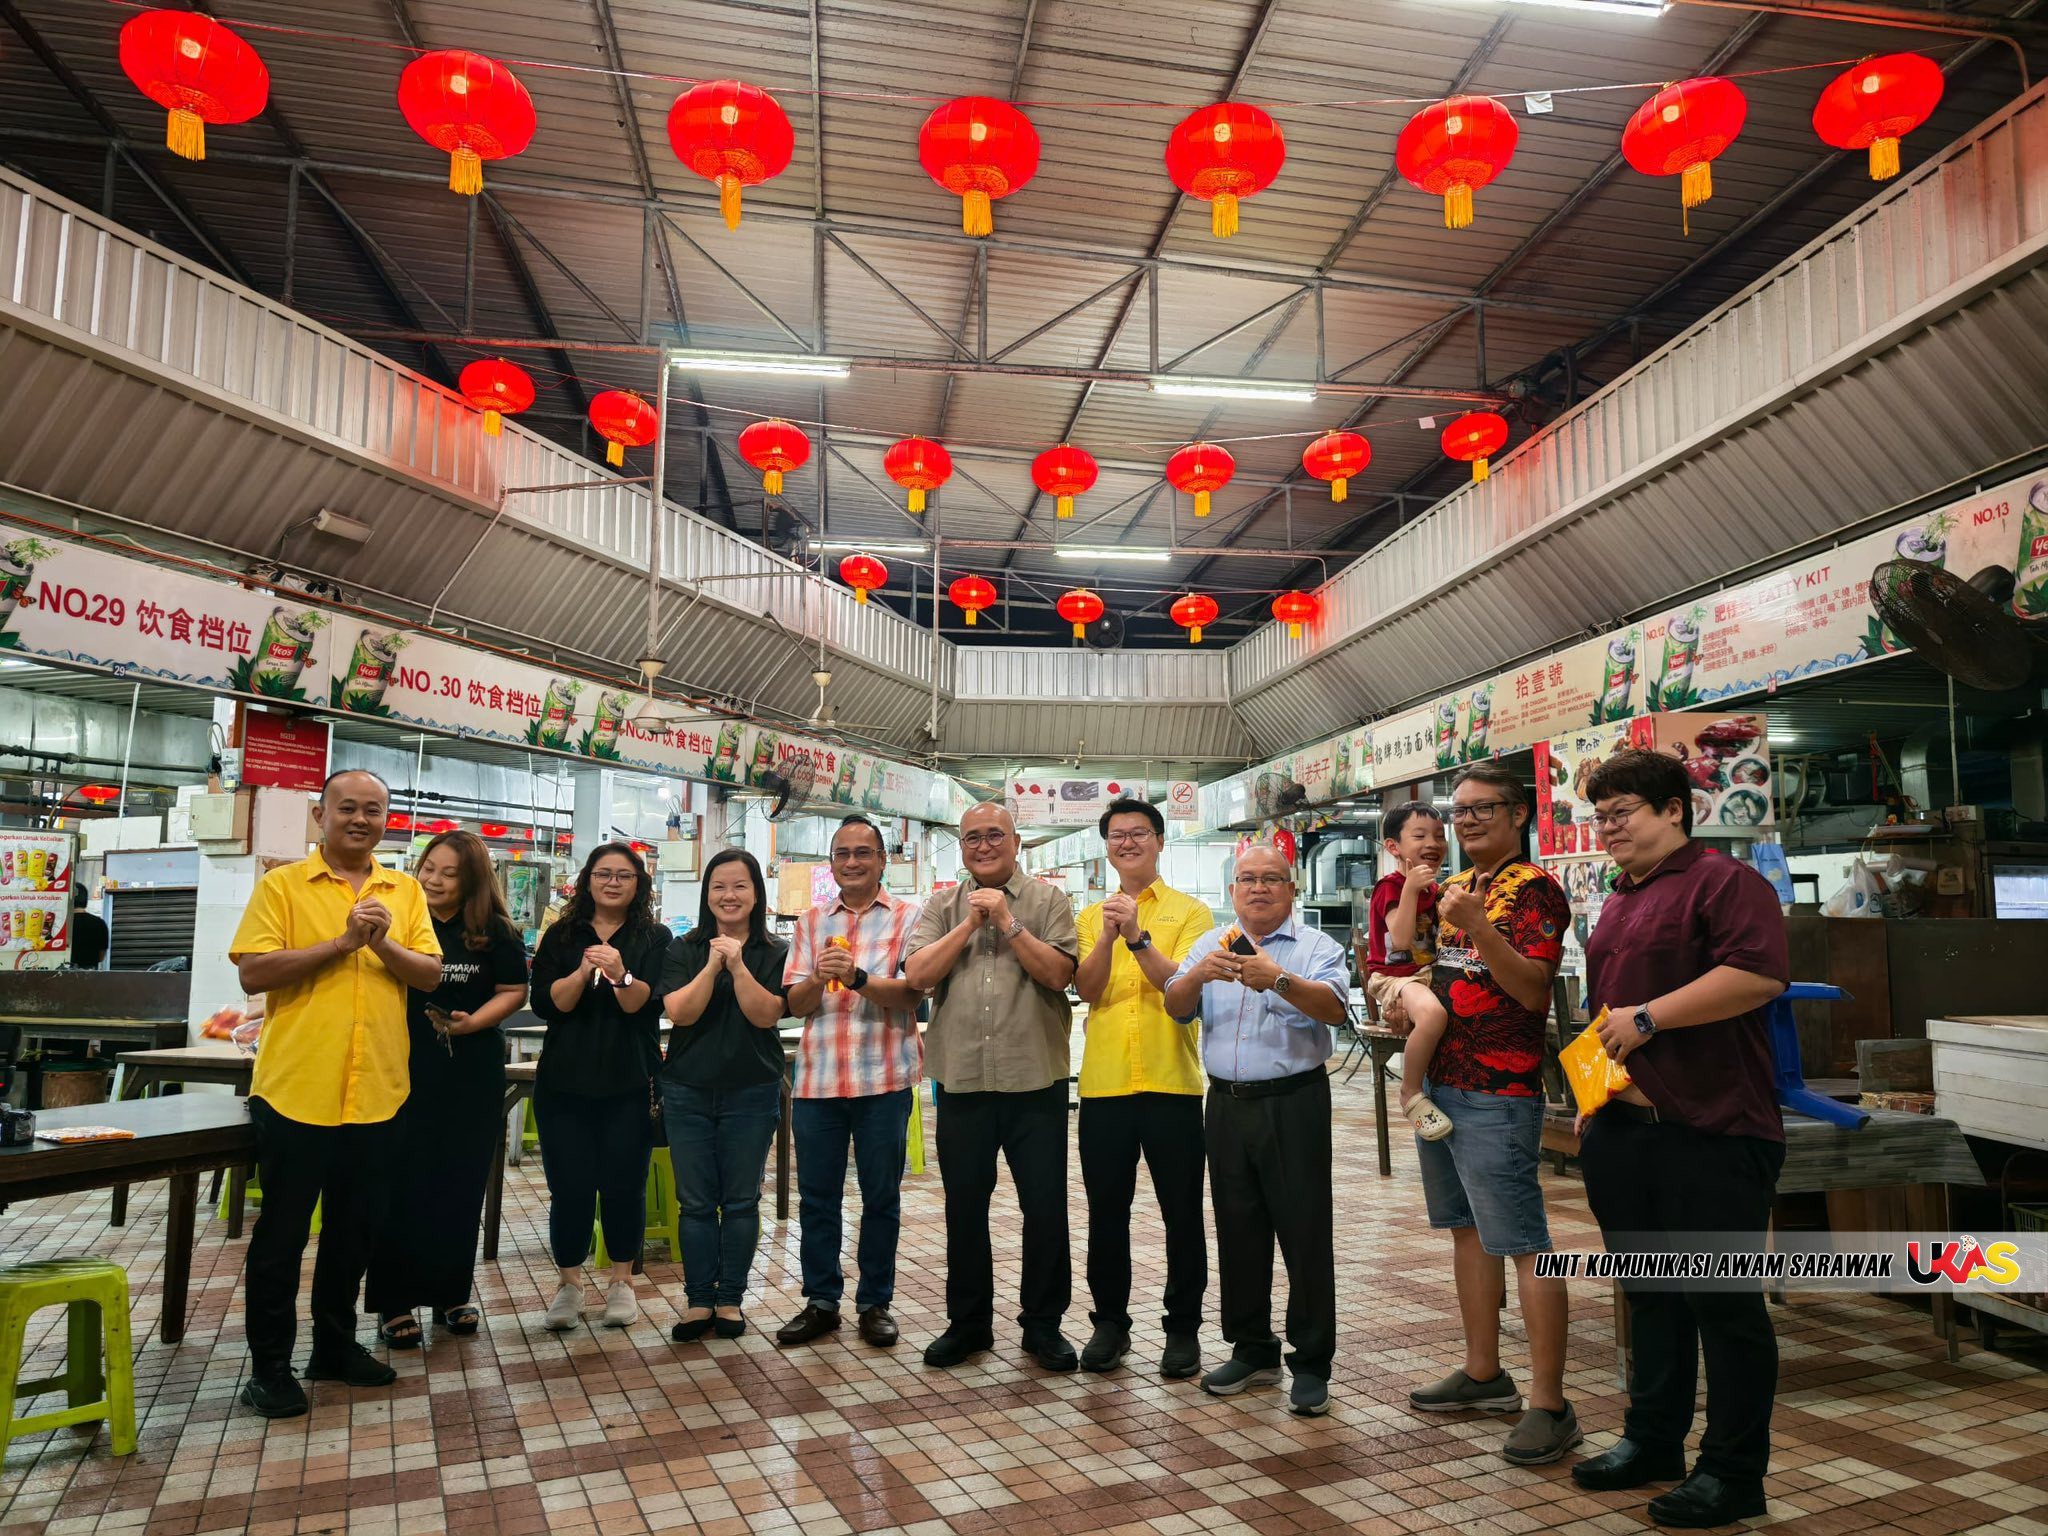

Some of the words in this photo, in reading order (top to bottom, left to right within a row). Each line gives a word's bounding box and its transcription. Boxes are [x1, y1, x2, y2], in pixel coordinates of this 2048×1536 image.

[1973, 502, 2010, 526] NO.13
[1806, 566, 1831, 588] KIT
[39, 581, 126, 627] NO.29
[136, 600, 252, 655] 饮食档位
[1646, 626, 1665, 641] NO.12
[272, 644, 293, 656] Yeo's
[114, 666, 126, 676] 29
[400, 666, 461, 698] NO.30
[1516, 662, 1564, 699] 拾壹號
[467, 680, 541, 718] 饮食档位
[662, 727, 712, 755] 饮食档位
[778, 742, 810, 766] NO.32
[813, 748, 836, 773] 饮食
[1305, 757, 1330, 785] 老夫子
